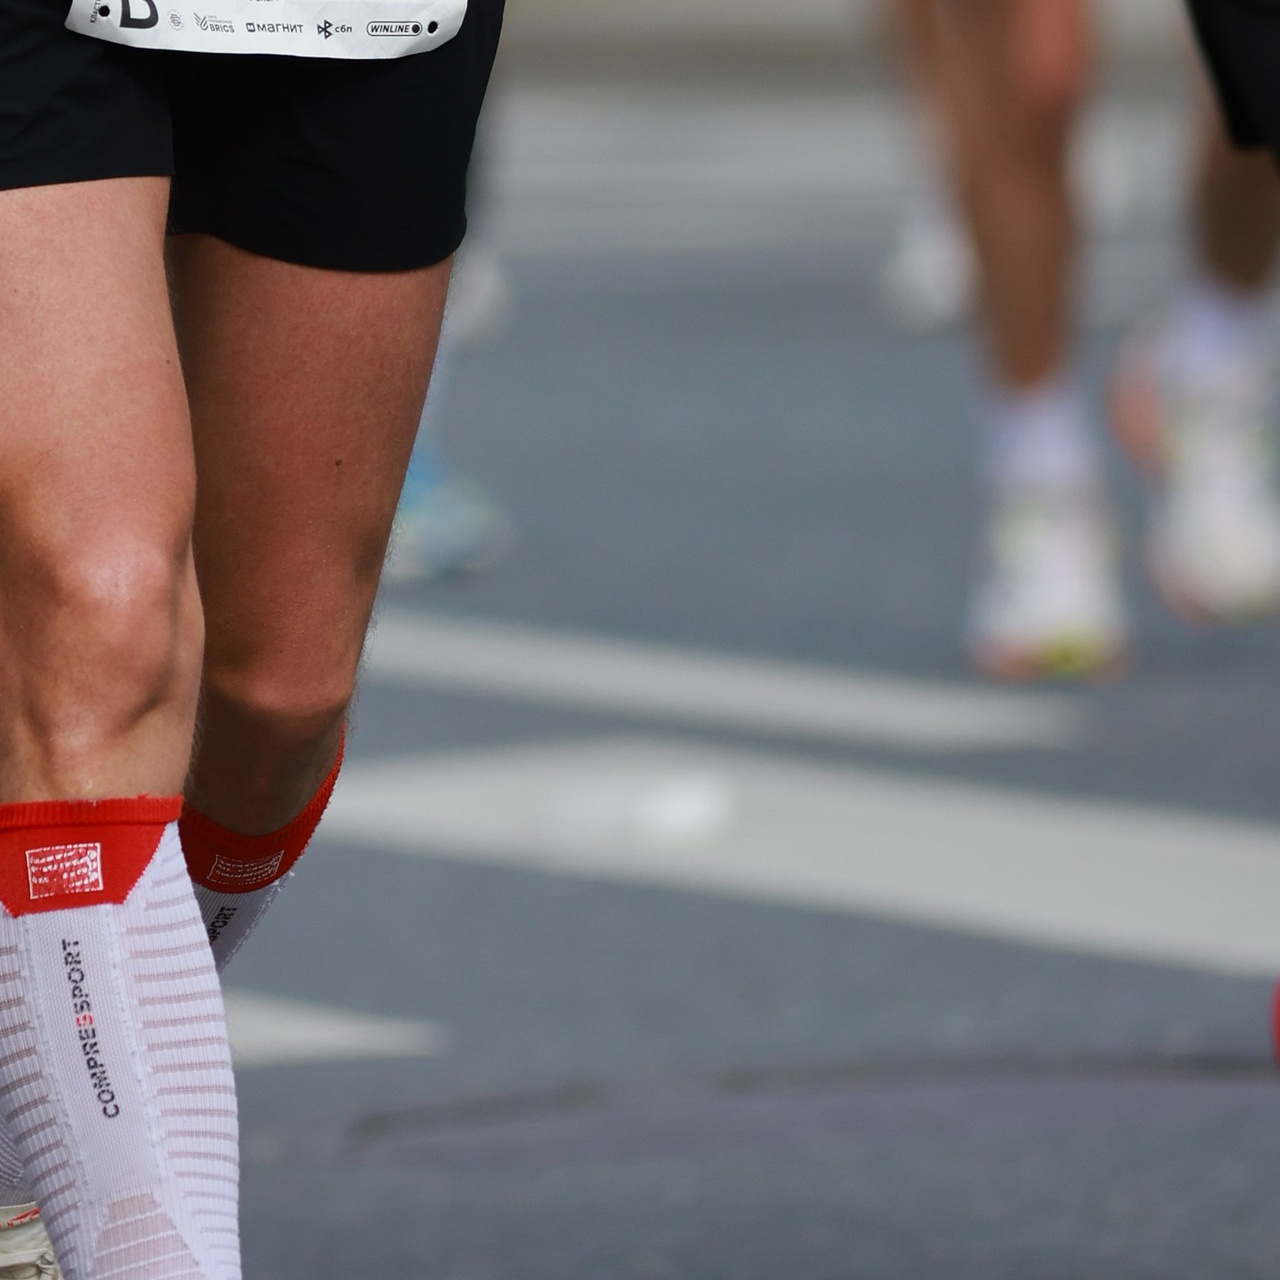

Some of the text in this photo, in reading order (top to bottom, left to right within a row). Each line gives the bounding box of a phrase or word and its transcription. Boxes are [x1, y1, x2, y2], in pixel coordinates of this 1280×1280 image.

[209, 23, 235, 33] BRICS
[334, 24, 353, 34] сбп
[370, 24, 410, 34] WINLINE
[61, 938, 120, 1119] COMPRESSPORT
